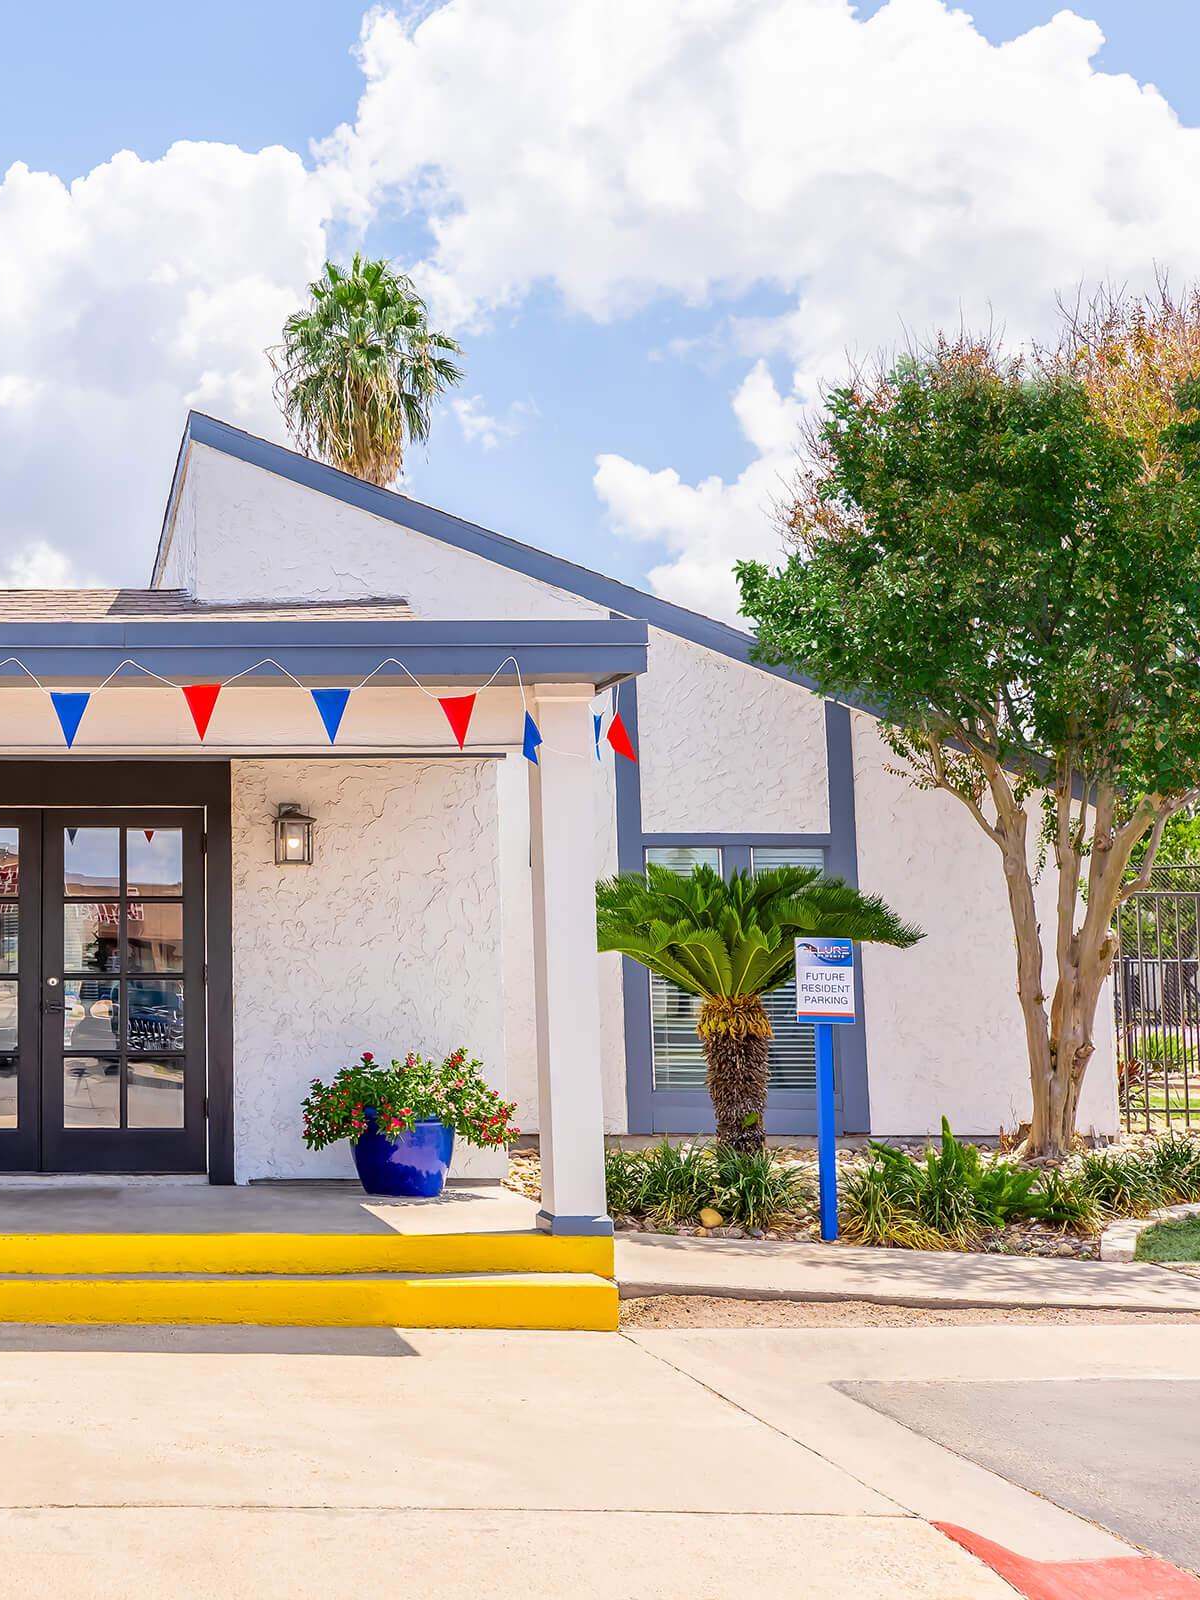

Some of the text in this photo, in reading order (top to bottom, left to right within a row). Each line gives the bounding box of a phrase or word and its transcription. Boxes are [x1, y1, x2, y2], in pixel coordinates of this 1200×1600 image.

[806, 973, 845, 981] FUTURE
[802, 984, 850, 993] RESIDENT
[804, 996, 848, 1004] PARKING
